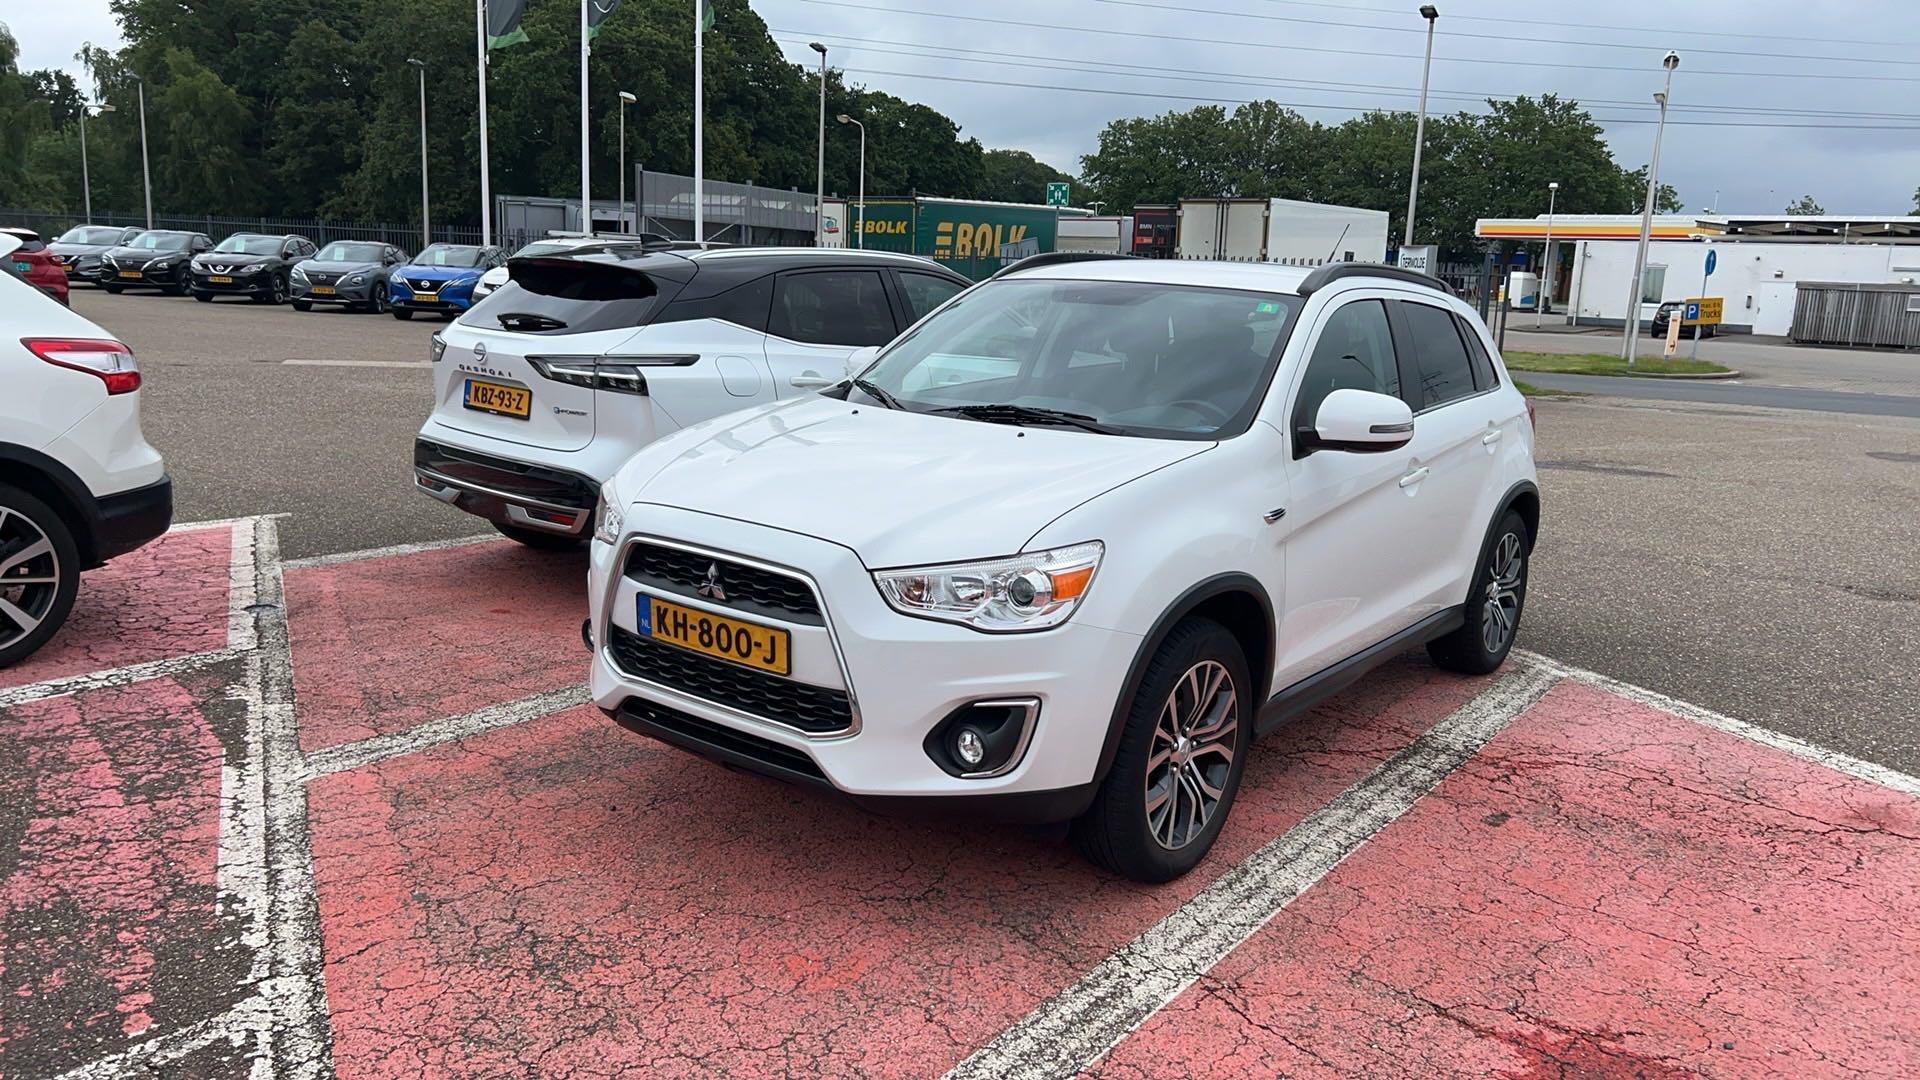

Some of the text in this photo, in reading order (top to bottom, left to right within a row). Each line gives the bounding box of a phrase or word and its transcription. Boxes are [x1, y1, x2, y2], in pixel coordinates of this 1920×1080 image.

[865, 220, 908, 234] BOLK
[955, 222, 1027, 259] BOLK
[1688, 305, 1696, 318] P
[1700, 308, 1721, 319] Trucks
[459, 364, 512, 377] QASHQAI
[473, 385, 524, 411] KBZ-93-Z
[641, 605, 776, 665] NL KH-800-J
